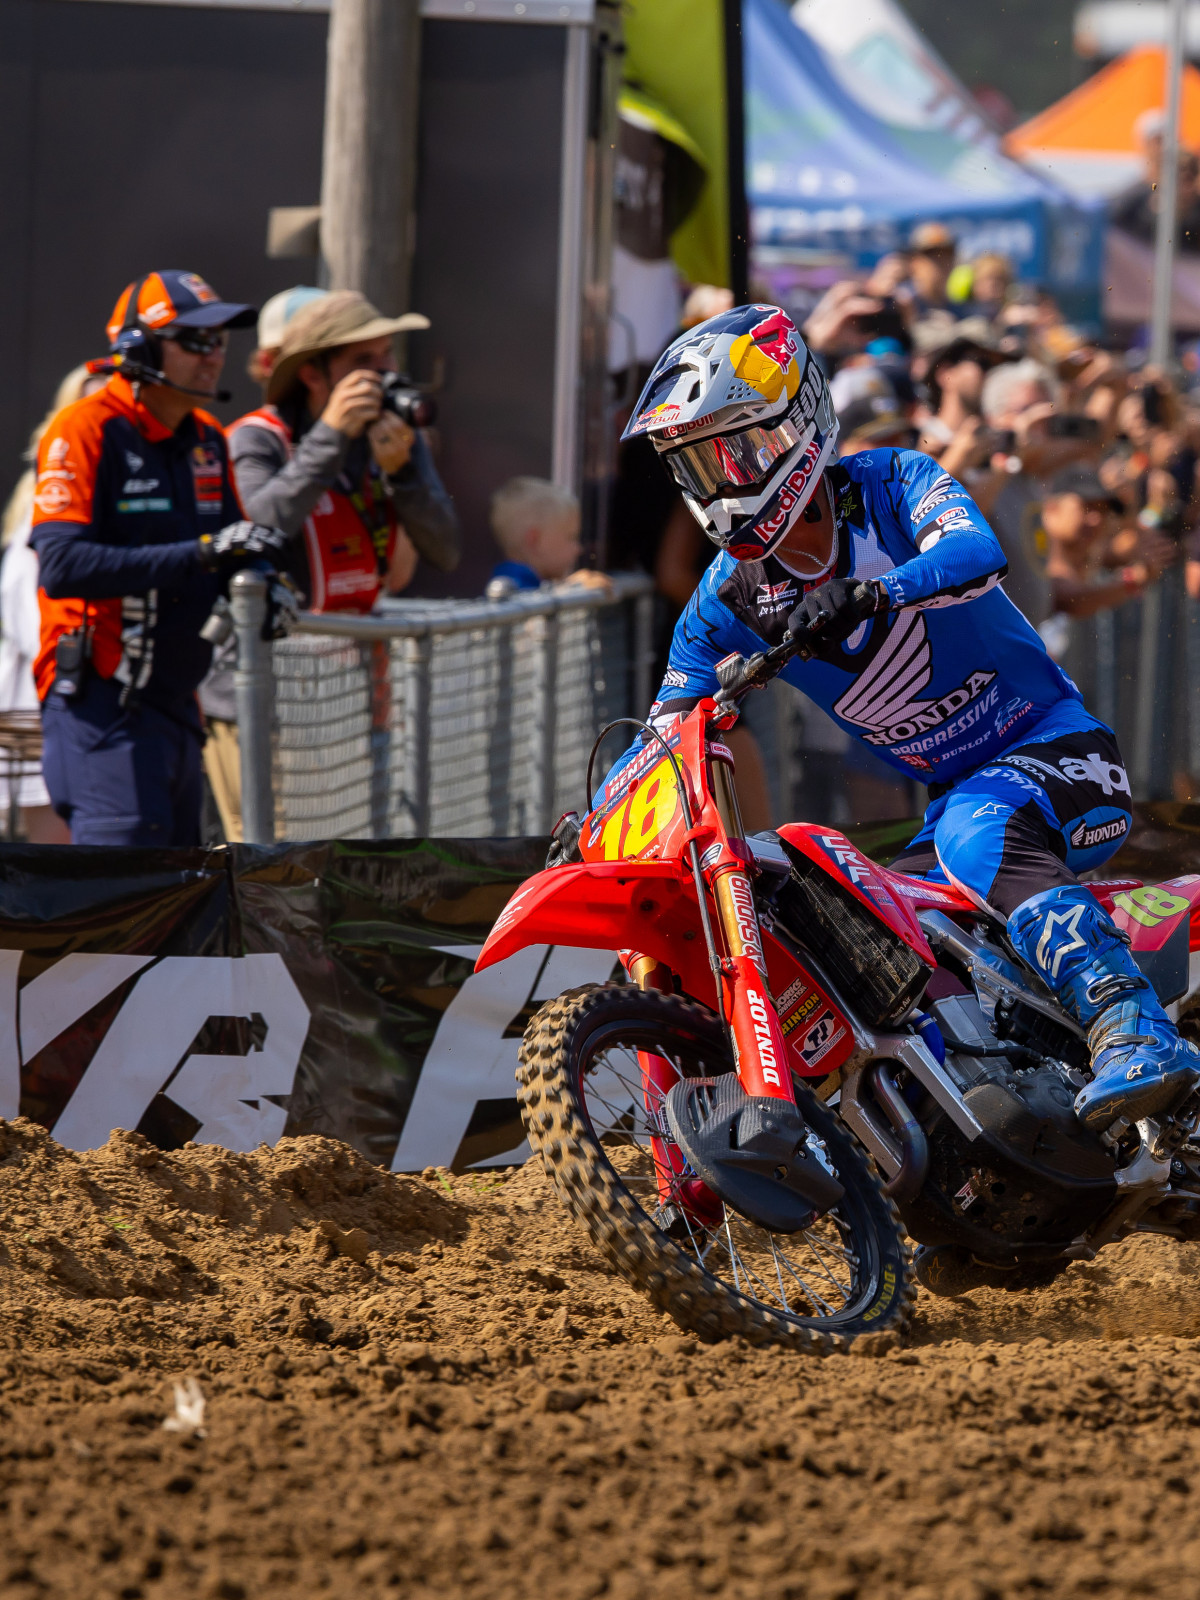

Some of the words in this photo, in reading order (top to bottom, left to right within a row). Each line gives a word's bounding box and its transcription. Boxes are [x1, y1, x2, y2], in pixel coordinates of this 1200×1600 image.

[939, 508, 967, 525] 100%
[862, 671, 996, 746] HONDA
[890, 685, 1000, 756] PROGRESSIVE
[998, 702, 1035, 738] RENTHAL
[942, 730, 991, 761] DUNLOP
[600, 753, 684, 861] 18
[1084, 818, 1127, 846] HONDA
[821, 835, 871, 884] CRF
[731, 874, 764, 948] SHOWA
[1112, 886, 1191, 928] 18
[778, 985, 809, 1017] ONNECTION
[781, 992, 820, 1037] HINSON
[746, 989, 781, 1087] DUNLOP
